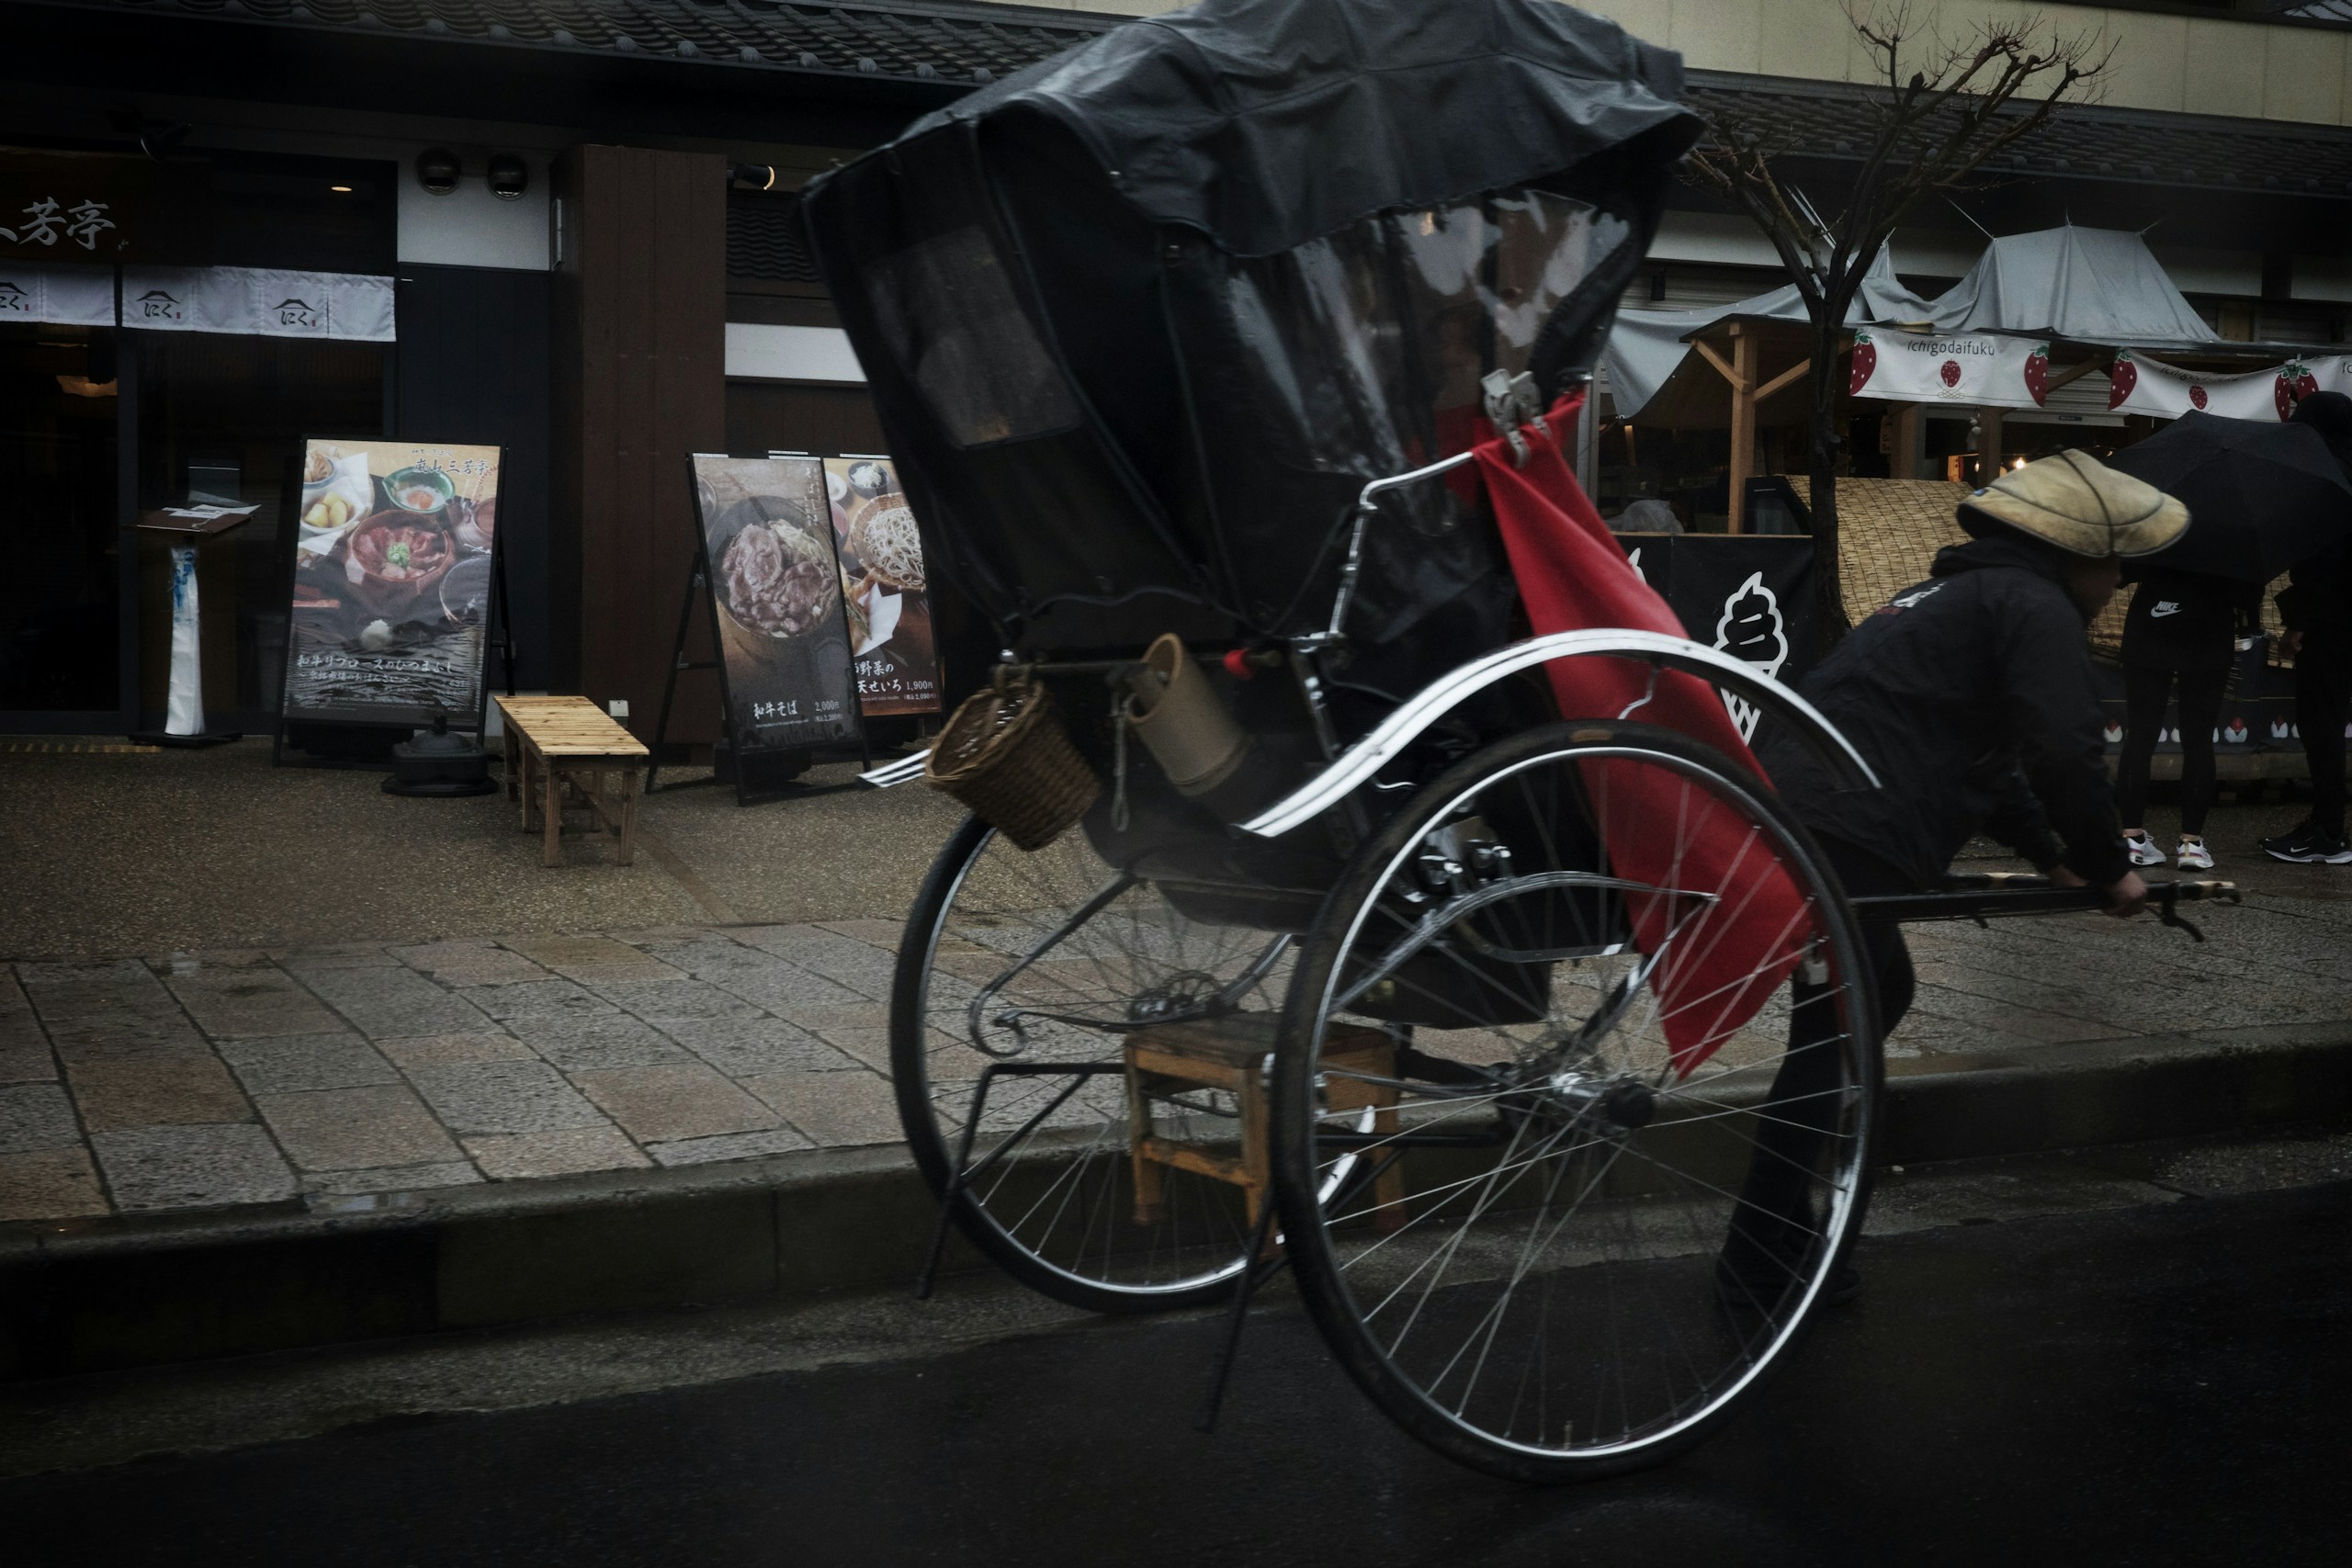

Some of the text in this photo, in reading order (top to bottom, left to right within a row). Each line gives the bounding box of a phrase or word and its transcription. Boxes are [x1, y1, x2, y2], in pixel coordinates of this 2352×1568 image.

[0, 196, 117, 250] 芳亭
[2155, 600, 2180, 611] NIKE
[753, 700, 798, 719] 和牛そば
